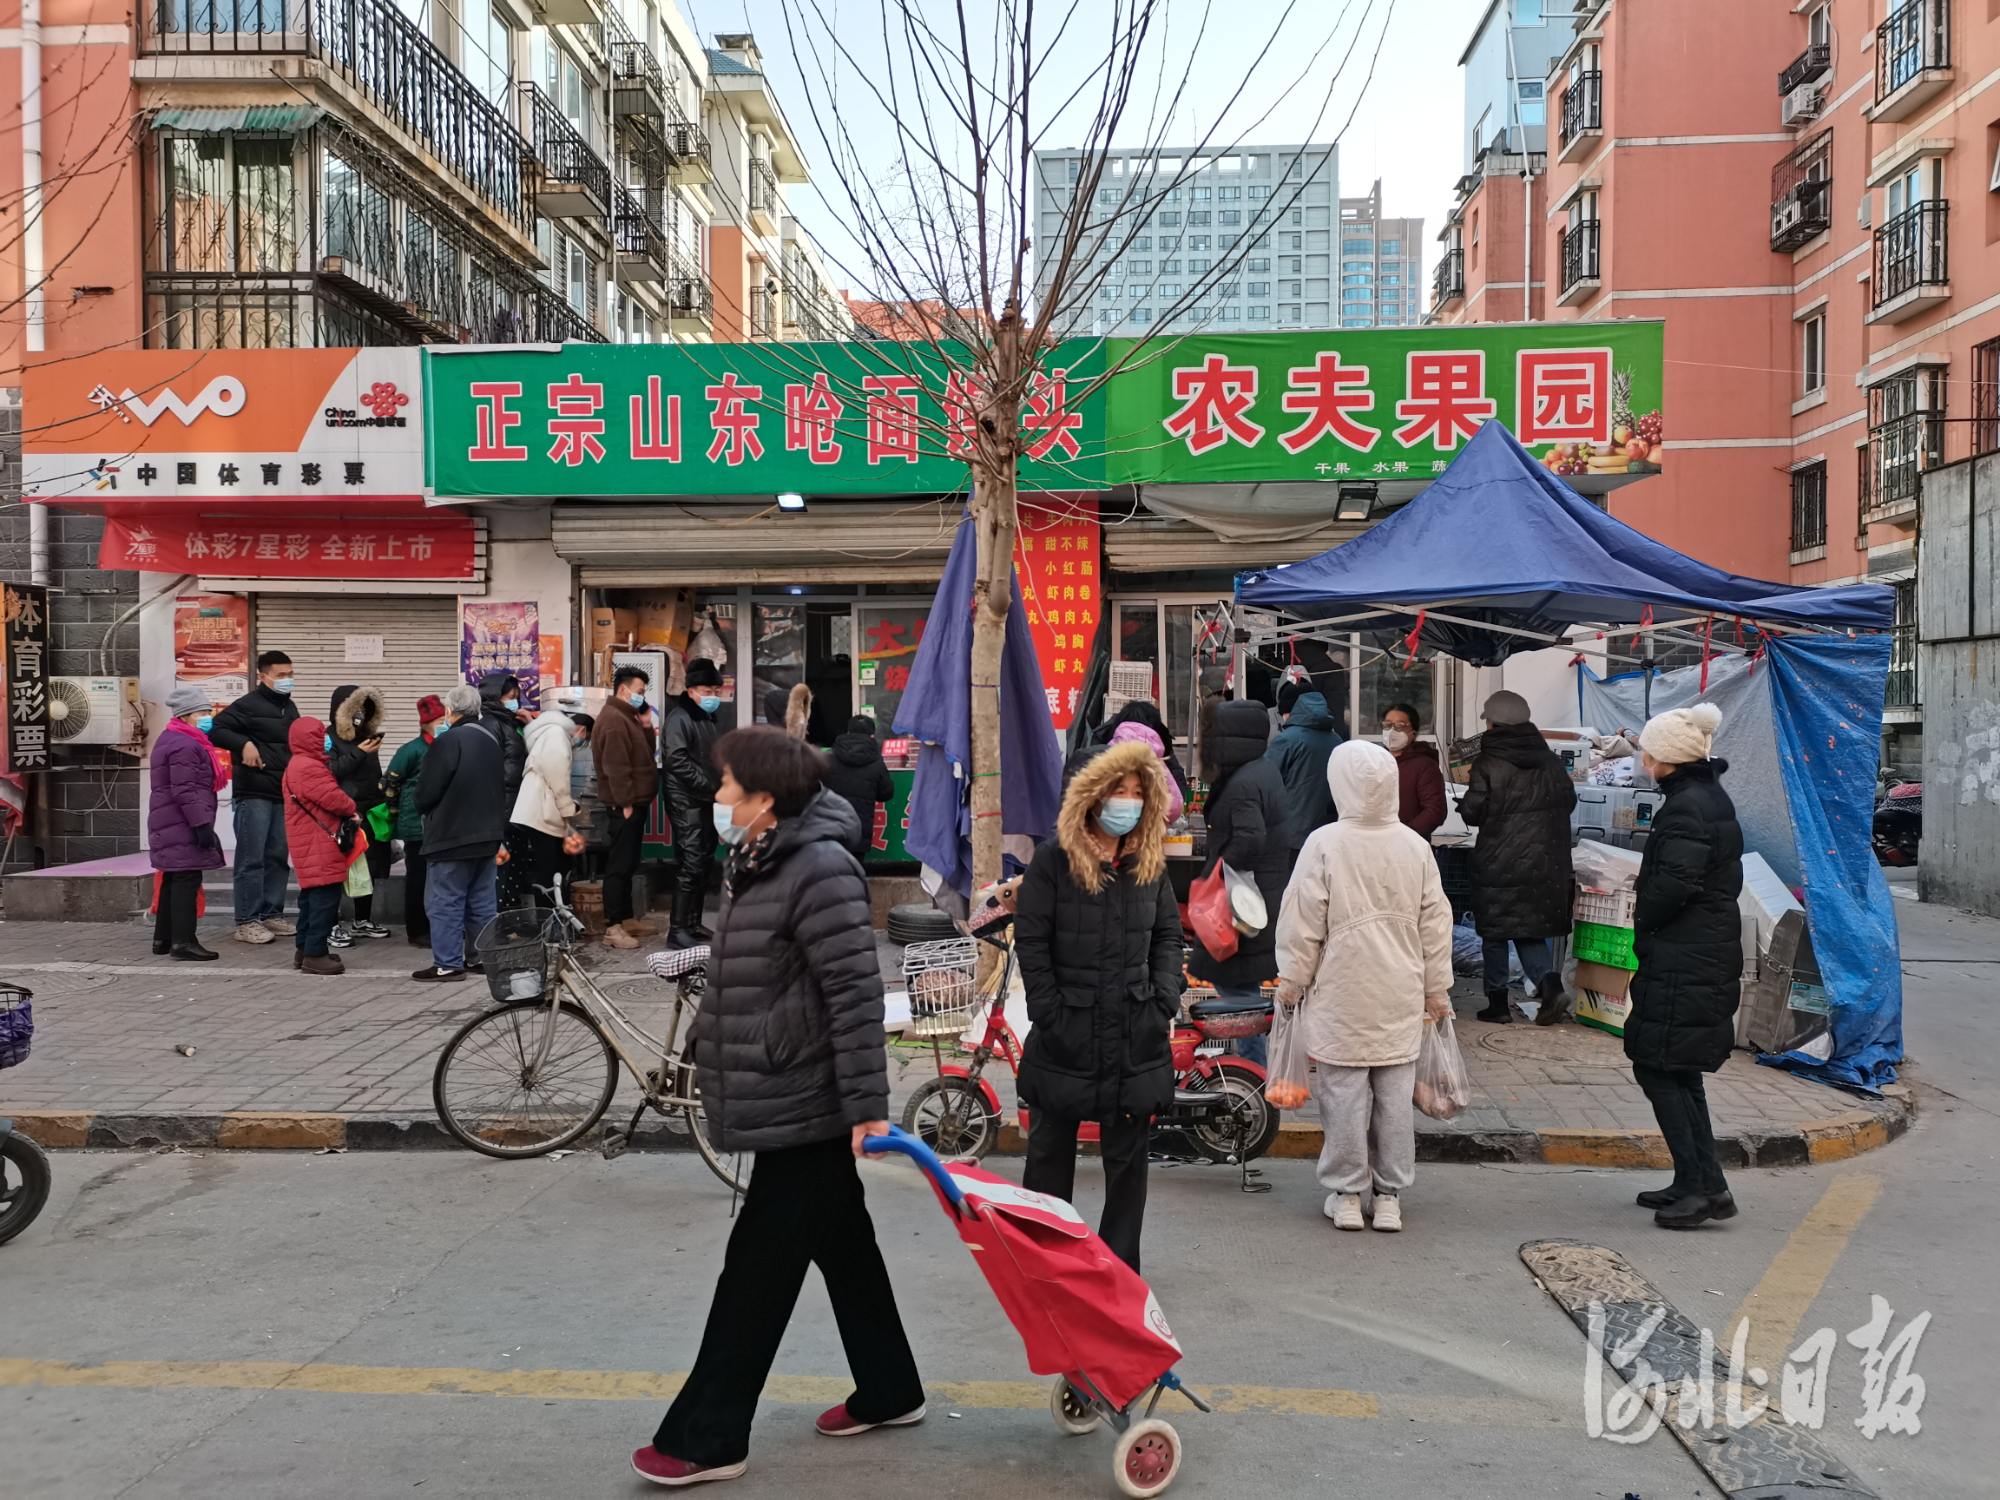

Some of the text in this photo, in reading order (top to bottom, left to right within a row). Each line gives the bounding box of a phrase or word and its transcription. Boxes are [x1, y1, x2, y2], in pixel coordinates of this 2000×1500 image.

[1163, 346, 1613, 456] 农夫果园
[137, 462, 365, 486] 中国体育彩票
[1315, 462, 1351, 474] 干果
[1372, 461, 1409, 473] 水果
[1046, 512, 1089, 526] 牛肉片
[185, 531, 435, 561] 体彩7星彩 全新上市
[1045, 536, 1089, 551] 甜不辣
[1045, 561, 1093, 576] 小红肠
[1047, 585, 1091, 600] 虾肉卷
[1047, 609, 1093, 624] 鸡肉丸
[1054, 633, 1084, 649] 鸡胸
[1054, 658, 1084, 673] 虾丸
[10, 592, 47, 768] 体育彩票
